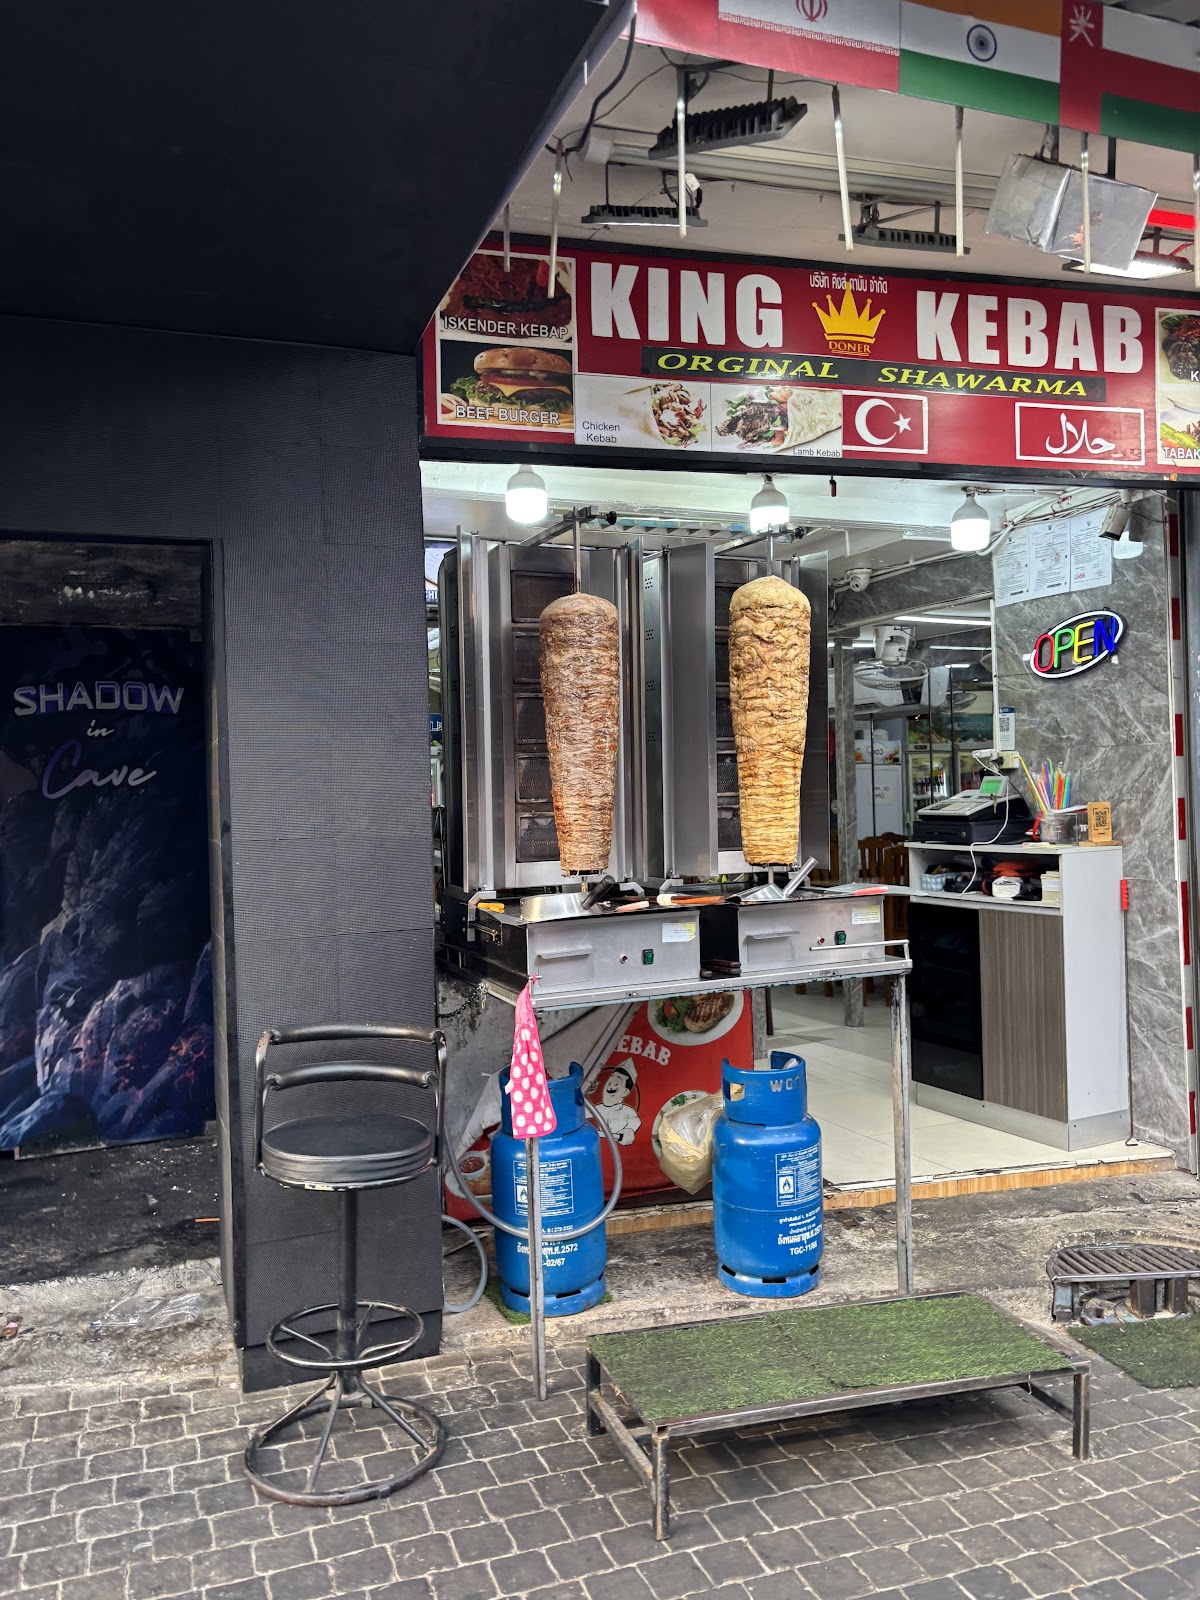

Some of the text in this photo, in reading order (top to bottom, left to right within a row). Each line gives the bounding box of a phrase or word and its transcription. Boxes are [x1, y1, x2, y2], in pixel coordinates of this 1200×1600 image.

[590, 261, 784, 349] KING
[444, 315, 569, 340] ISKENDER KEBAP
[916, 290, 1143, 374] KEBAB
[657, 353, 1088, 397] ORGINAL SHAWARMA
[456, 405, 560, 425] BEEF BURGER
[582, 420, 621, 432] Chicken
[586, 432, 617, 443] Kebab
[1045, 412, 1116, 455] حلال
[792, 447, 841, 458] Lamb Kebab
[1033, 616, 1117, 673] OPEN
[13, 681, 185, 717] SHADOW
[86, 719, 115, 737] in
[41, 738, 158, 800] Cave
[613, 1034, 671, 1066] EBAB
